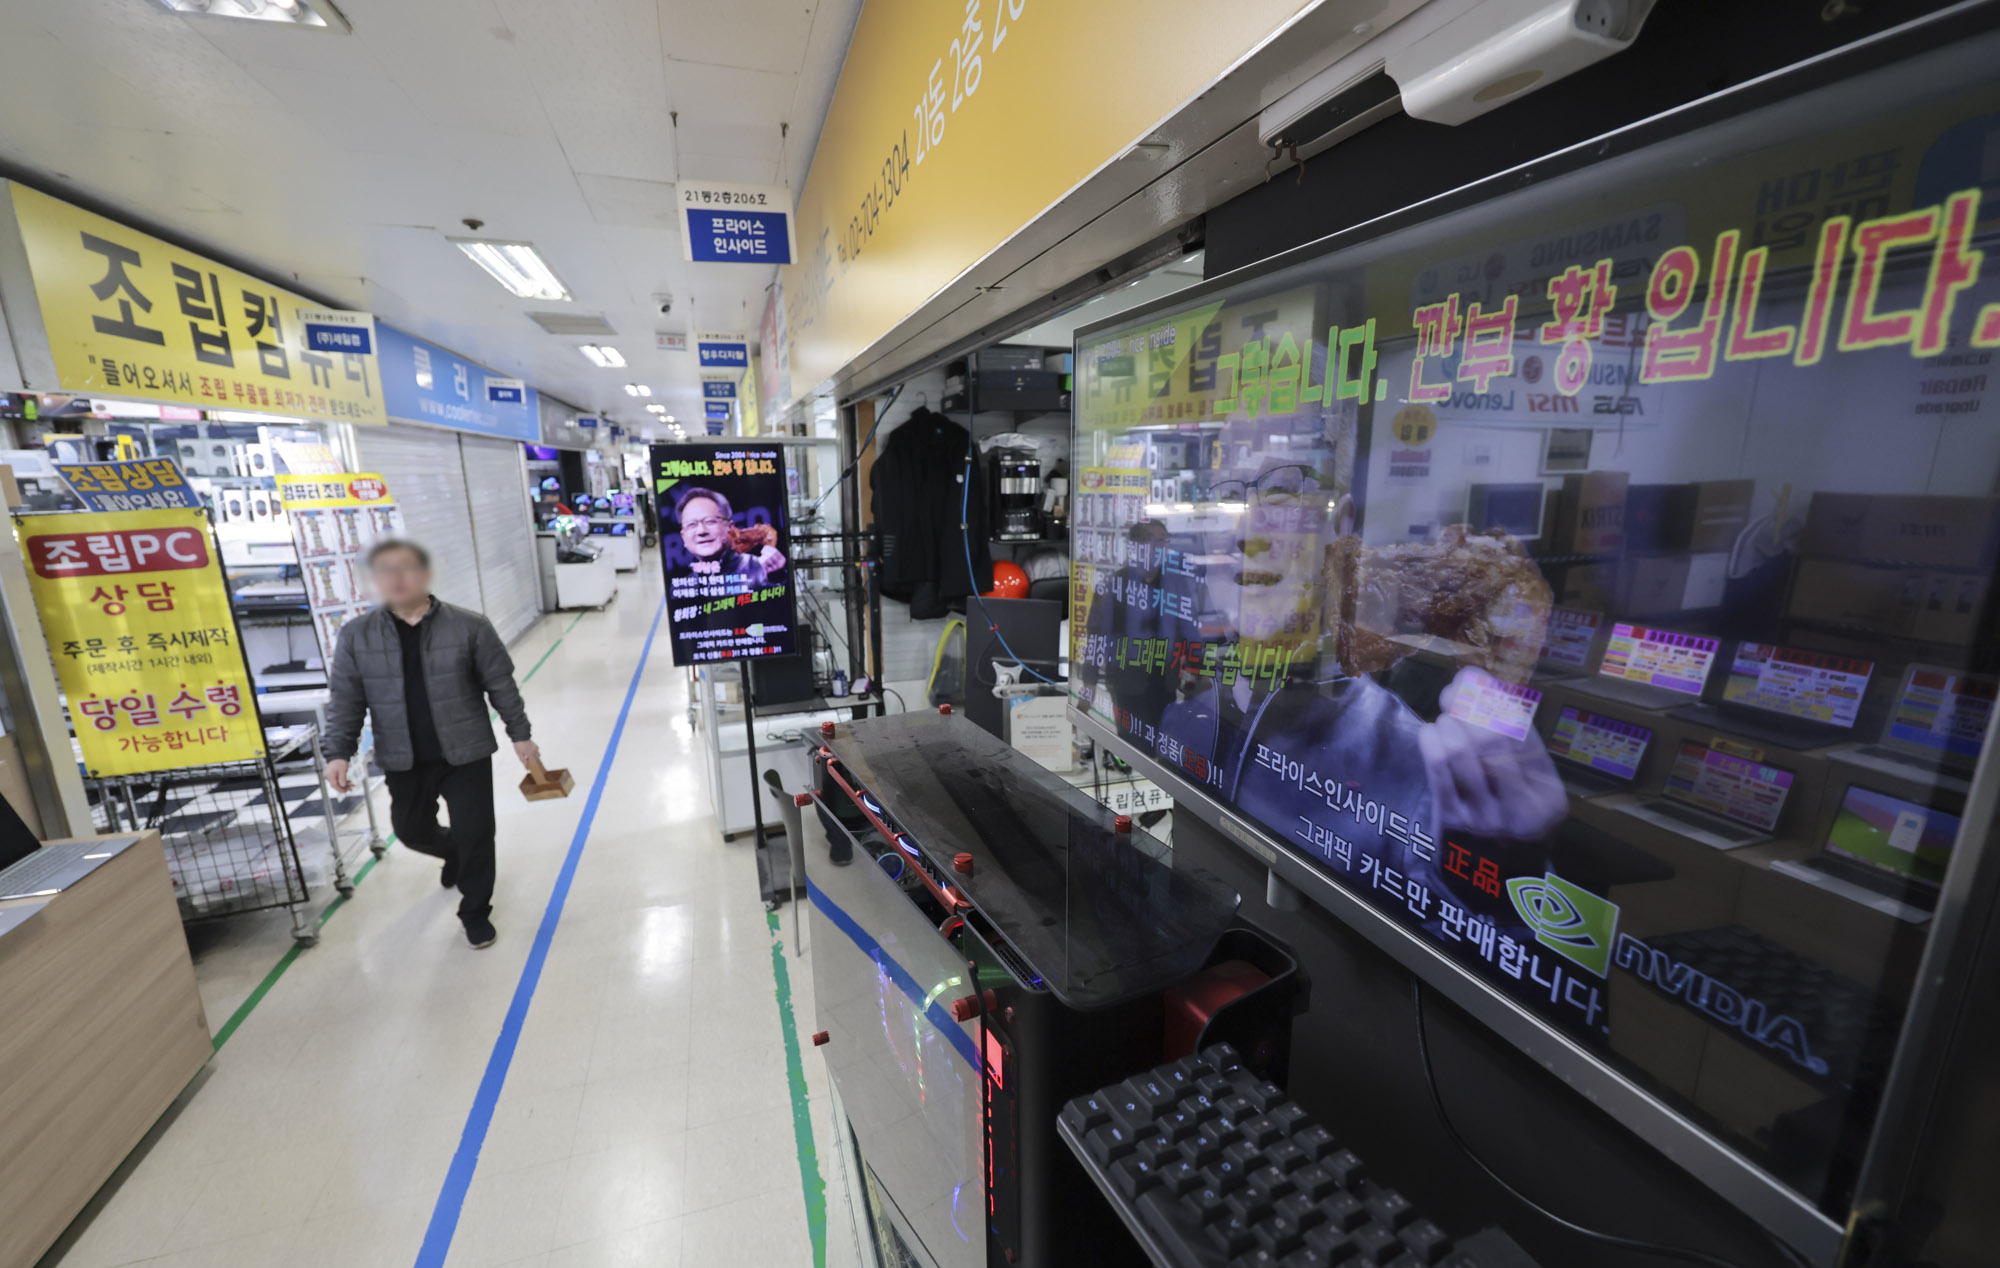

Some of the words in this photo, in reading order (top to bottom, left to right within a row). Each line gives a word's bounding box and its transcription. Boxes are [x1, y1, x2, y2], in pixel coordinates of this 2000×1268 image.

[913, 57, 946, 166] 21동
[684, 189, 768, 205] 21동2층206호
[711, 217, 766, 235] 프라이스
[713, 237, 768, 254] 인사이드
[1213, 317, 1388, 419] 그렇습니다.
[1408, 291, 1519, 402] 깐부
[1540, 257, 1617, 396] 황
[1639, 187, 2000, 384] 입니다.
[200, 375, 228, 401] 조립
[660, 460, 712, 477] 그렇습니다.
[714, 451, 730, 459] Since
[58, 459, 184, 492] 조립상담
[281, 482, 321, 501] 컴퓨터
[321, 481, 347, 499] 조립
[43, 530, 198, 572] 조립PC
[90, 581, 176, 615] 상담
[1111, 576, 1123, 603] 내
[1125, 579, 1149, 611] 삼성
[62, 637, 106, 658] 주문
[117, 635, 139, 655] 후
[146, 627, 230, 650] 즉시제작
[87, 657, 145, 676] (제작시간
[148, 655, 181, 673] 1시간
[183, 653, 214, 668] 내외)
[1115, 636, 1129, 671] 내
[1129, 637, 1169, 677] 그래픽
[1170, 639, 1218, 680] 카드로
[1221, 640, 1294, 693] 쏩니다!
[79, 691, 160, 732] 당일
[167, 679, 243, 720] 수령
[118, 725, 230, 754] 가능합니다
[1144, 724, 1156, 748] 과
[1253, 742, 1437, 863] 프라이스인사이드는
[1443, 840, 1501, 898] 正品
[1294, 814, 1354, 872] 그래픽
[1358, 851, 1432, 920] 카드만
[1437, 896, 1611, 1037] 판매합니다.
